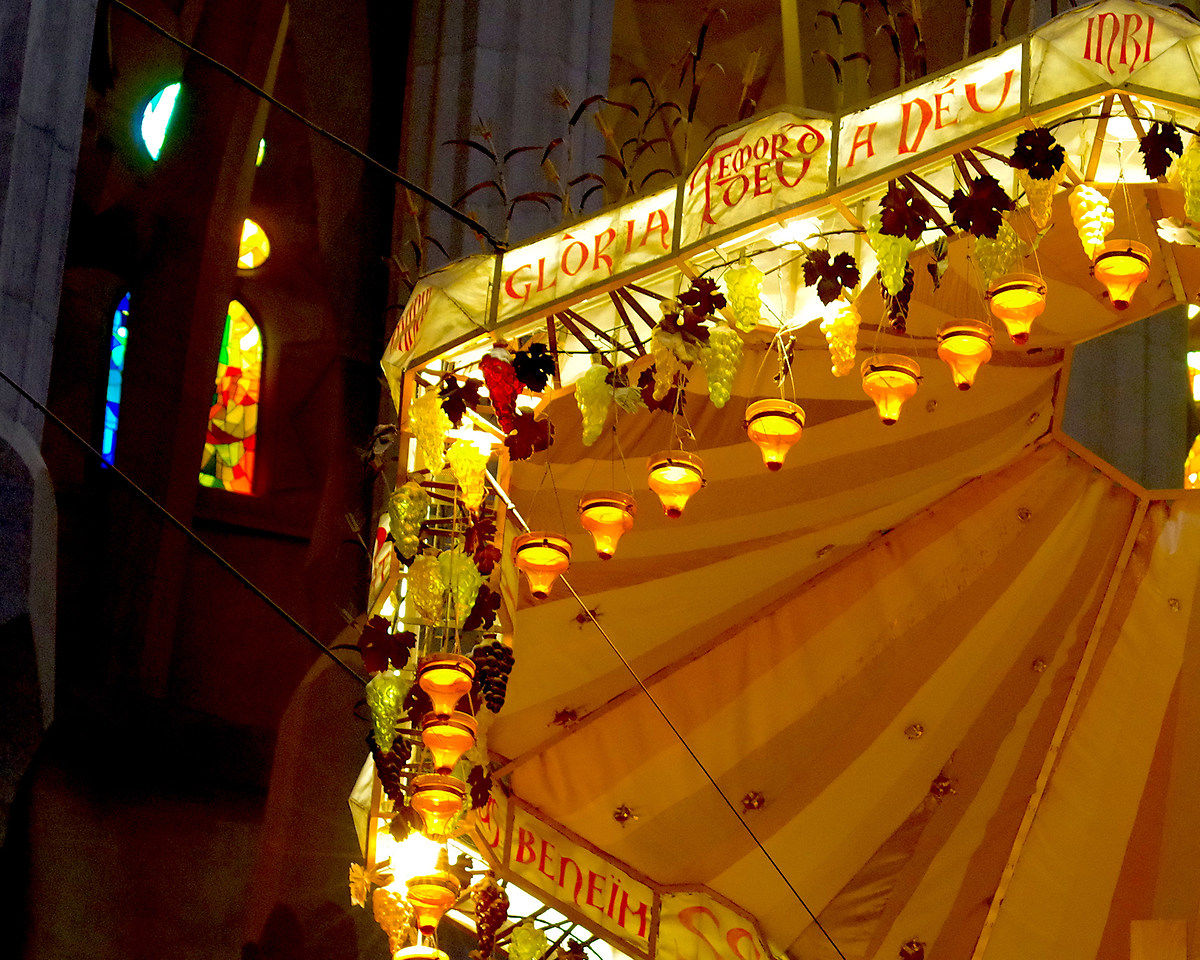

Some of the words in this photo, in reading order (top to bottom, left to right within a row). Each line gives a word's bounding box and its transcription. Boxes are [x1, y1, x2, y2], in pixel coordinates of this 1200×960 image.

[1083, 13, 1154, 75] INRI
[847, 122, 877, 168] A
[898, 69, 1015, 155] DÉU
[505, 209, 669, 310] GLÒRIA
[515, 827, 648, 938] BENEÏM
